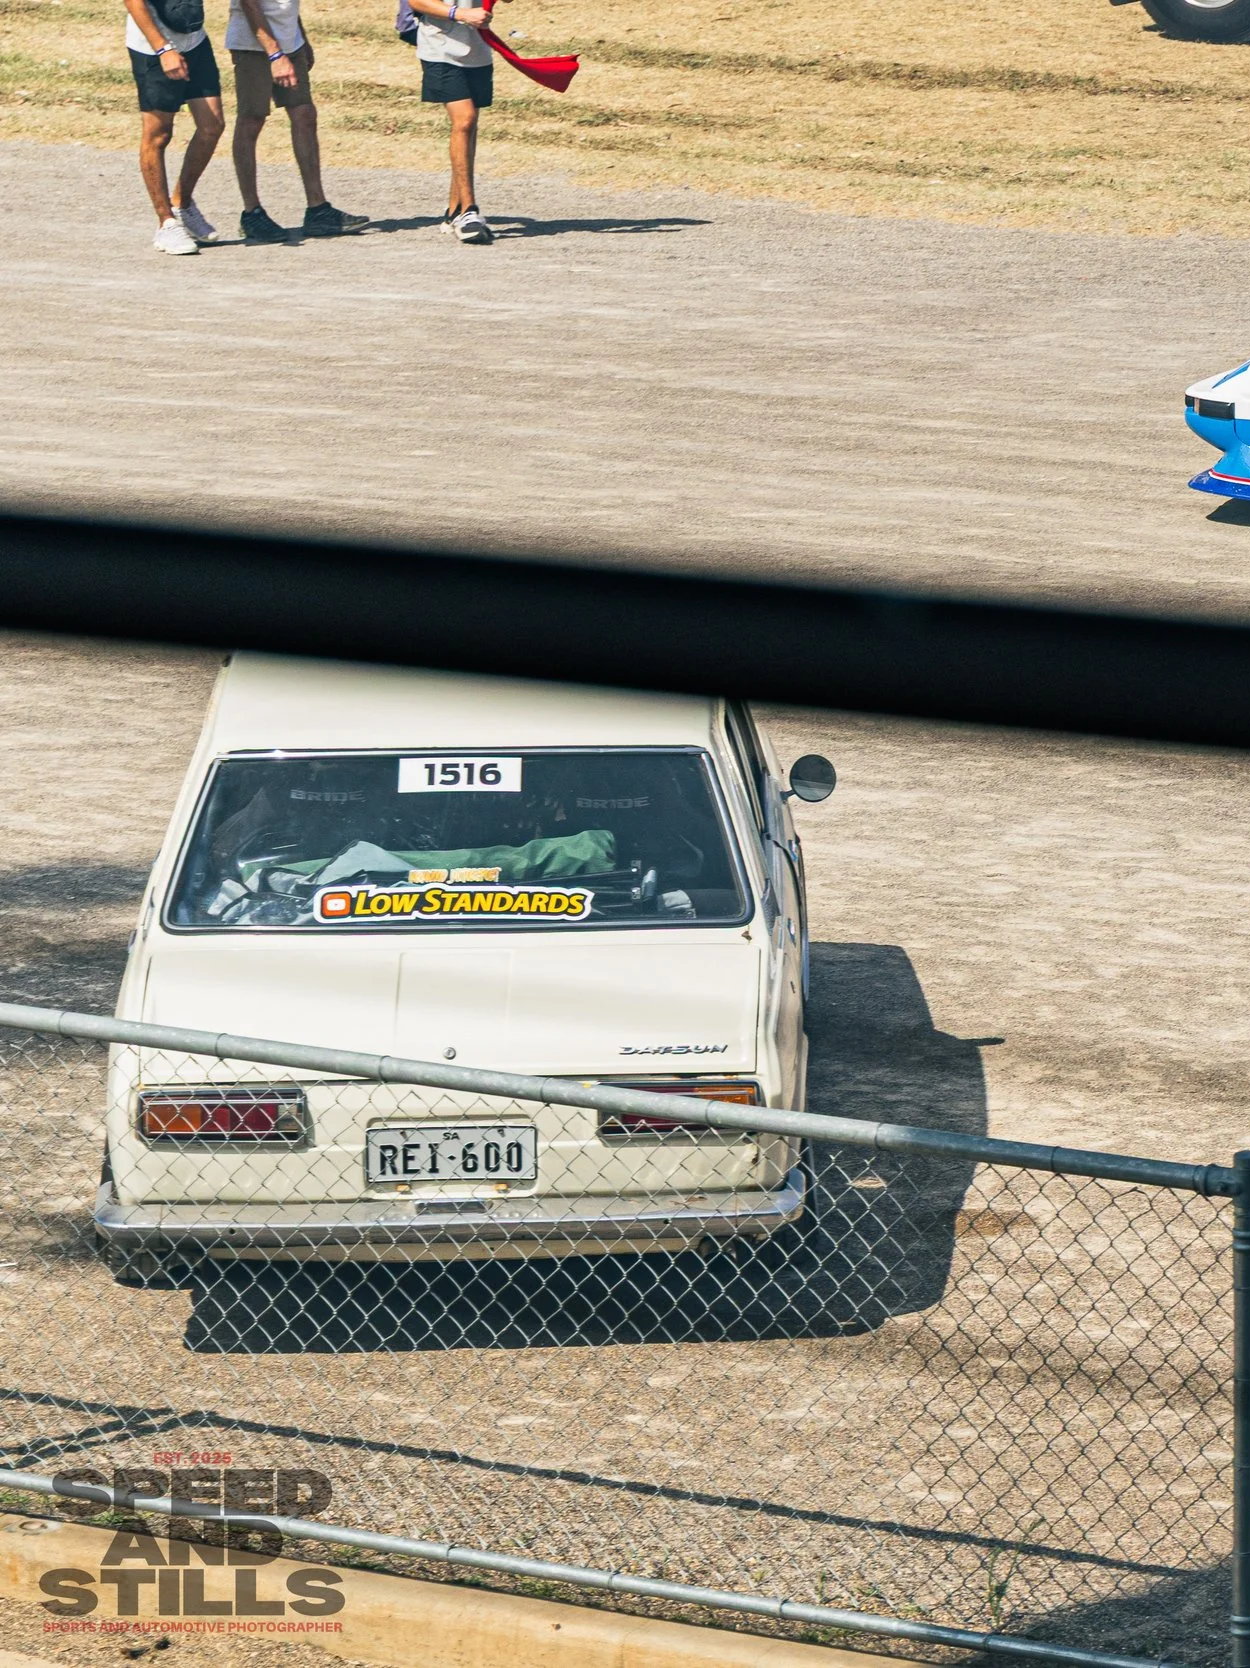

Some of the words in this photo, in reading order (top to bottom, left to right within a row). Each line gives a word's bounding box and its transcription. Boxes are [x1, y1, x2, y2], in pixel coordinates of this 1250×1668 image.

[424, 763, 501, 786] 1516
[619, 1044, 728, 1055] DATSUN
[442, 1132, 460, 1140] SA
